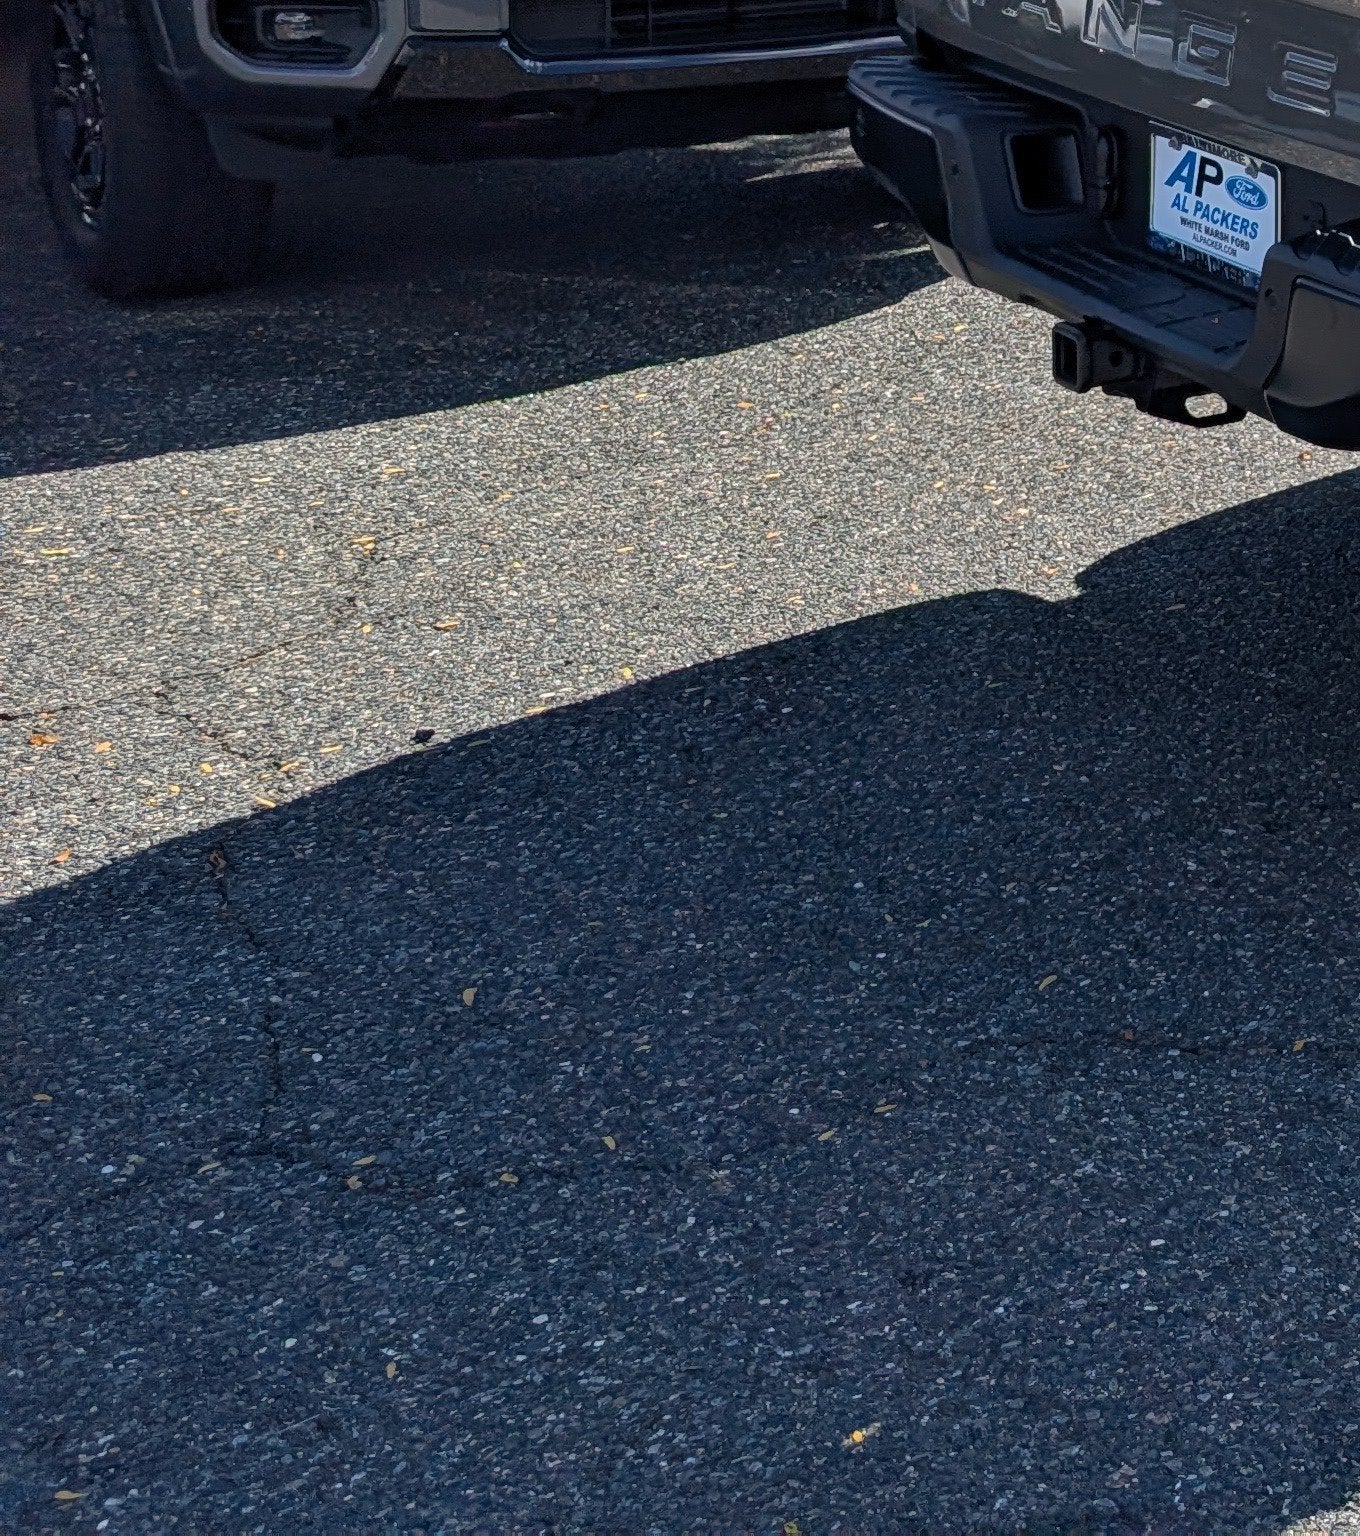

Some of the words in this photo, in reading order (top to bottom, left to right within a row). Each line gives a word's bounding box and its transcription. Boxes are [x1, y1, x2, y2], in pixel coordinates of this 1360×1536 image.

[1164, 150, 1224, 198] AP
[1232, 179, 1260, 206] Ford
[1171, 192, 1190, 214] AL
[1193, 200, 1260, 240] PACKERS
[1180, 216, 1203, 233] WHITE
[1204, 225, 1230, 243] MARSH
[1230, 235, 1251, 251] FORD
